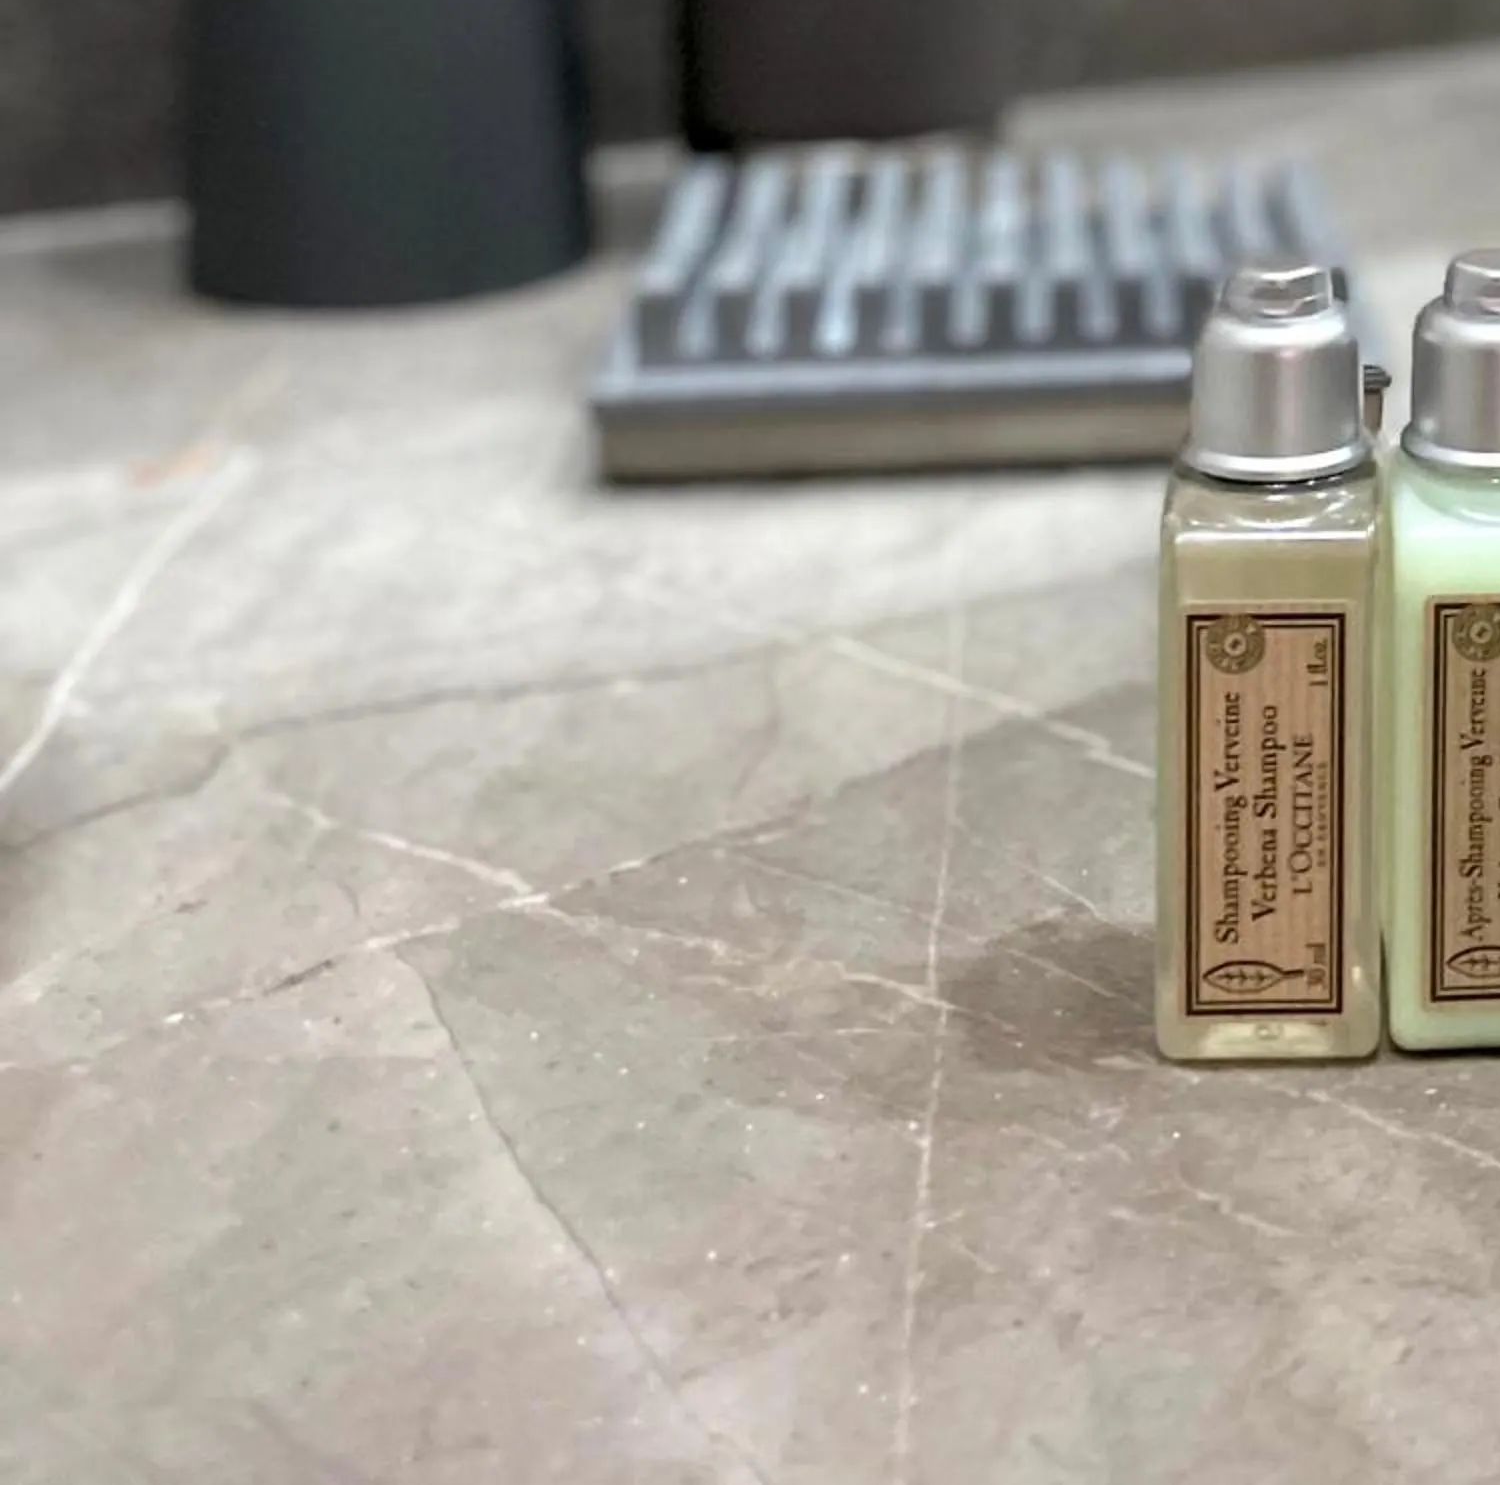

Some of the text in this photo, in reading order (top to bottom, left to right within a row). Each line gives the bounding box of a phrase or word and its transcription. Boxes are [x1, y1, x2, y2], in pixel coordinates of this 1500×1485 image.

[1213, 690, 1241, 792] Verveine
[1459, 668, 1487, 751] Verveine
[1213, 794, 1248, 944] Shampooing
[1251, 705, 1287, 923] Verbena Shampoo
[1288, 732, 1314, 894] L'OCCITANE
